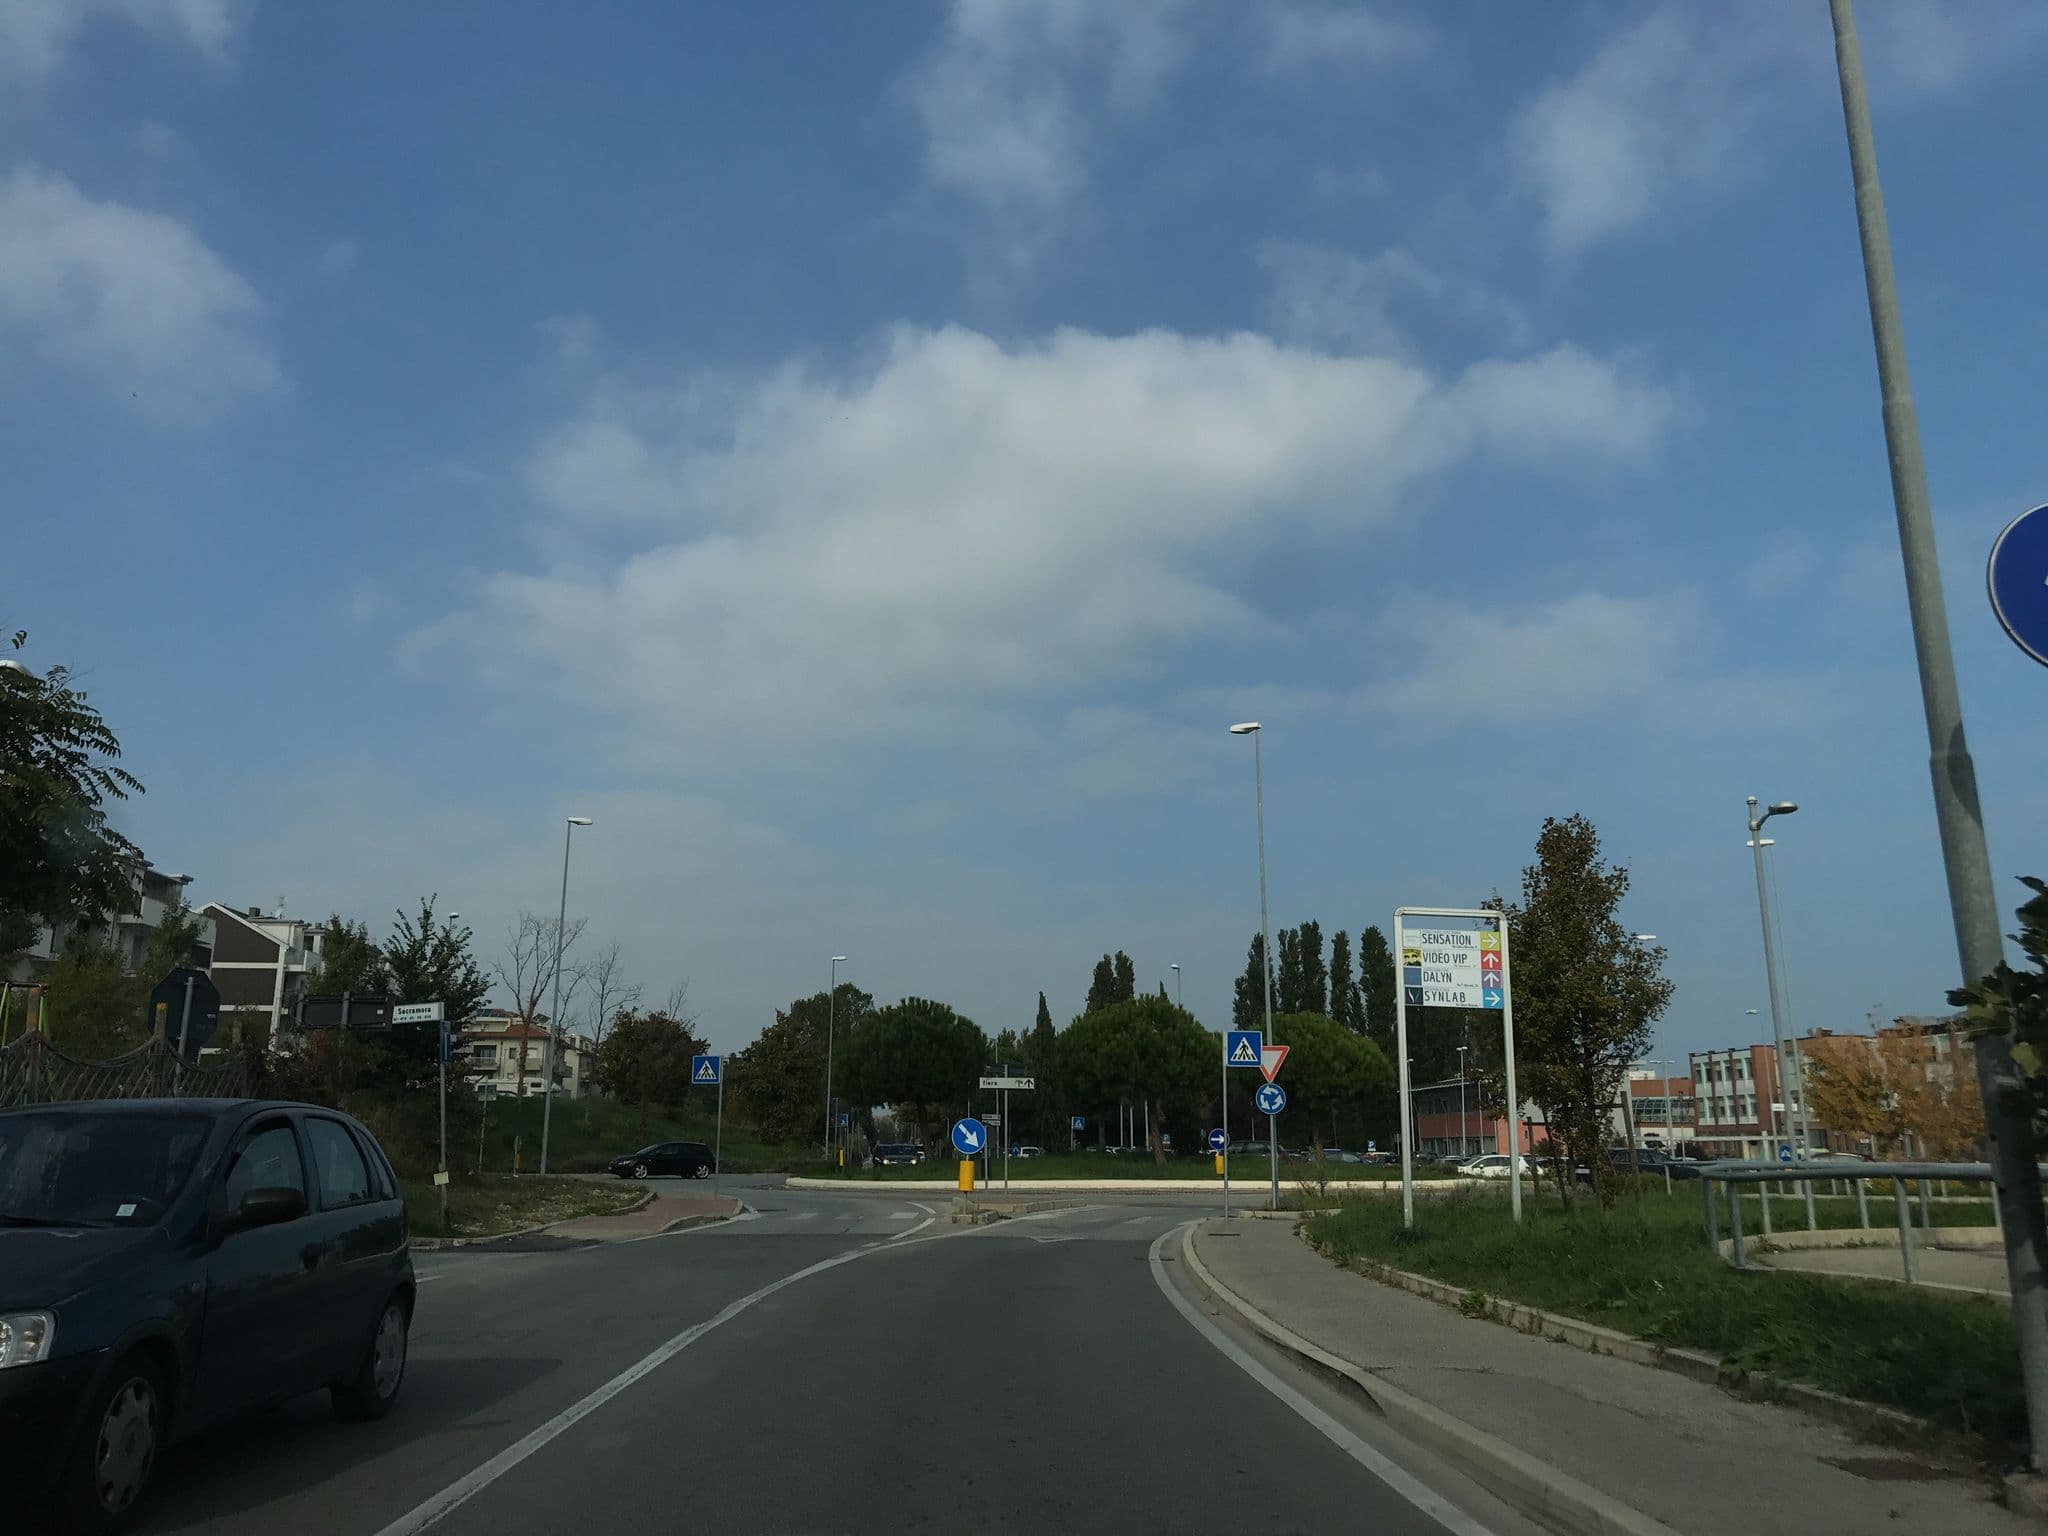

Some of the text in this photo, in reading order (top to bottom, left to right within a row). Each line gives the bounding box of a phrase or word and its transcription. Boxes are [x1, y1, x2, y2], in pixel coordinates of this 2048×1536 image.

[1422, 933, 1471, 945] SENSATION
[1422, 952, 1468, 964] VIDEO VIP
[1423, 971, 1452, 983] DALYN
[1424, 990, 1466, 1003] SYNLAB
